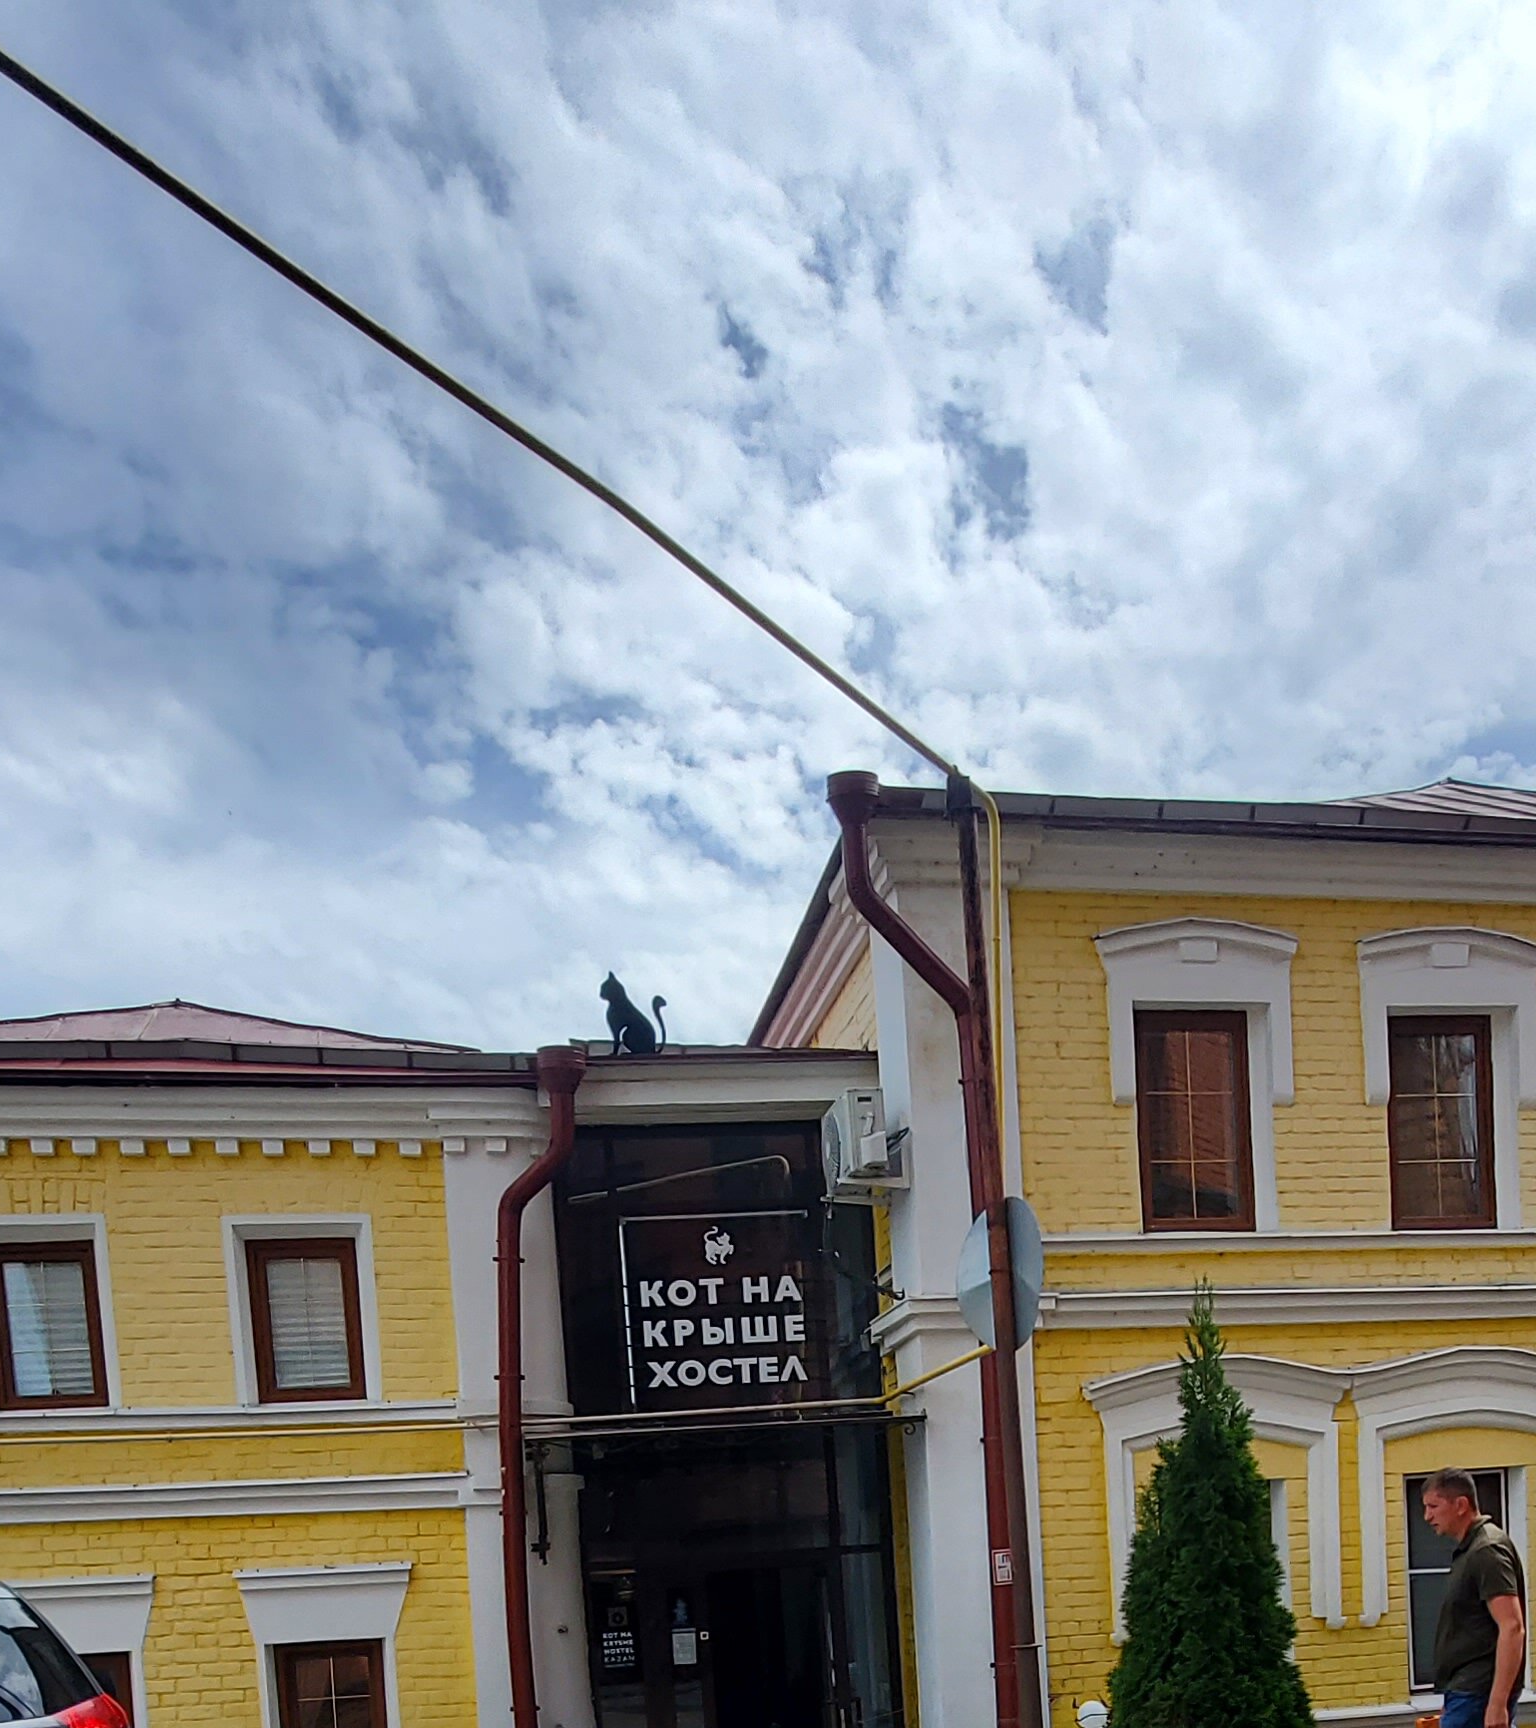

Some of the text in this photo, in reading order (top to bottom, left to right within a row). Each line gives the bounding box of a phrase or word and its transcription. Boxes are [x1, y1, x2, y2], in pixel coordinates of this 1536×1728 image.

[639, 1275, 803, 1308] КОТ НА
[642, 1313, 806, 1348] КРЫШЕ
[646, 1355, 809, 1388] ХОСТЕЛ
[603, 1647, 635, 1655] HOSTEL
[604, 1655, 635, 1663] KAZAN
